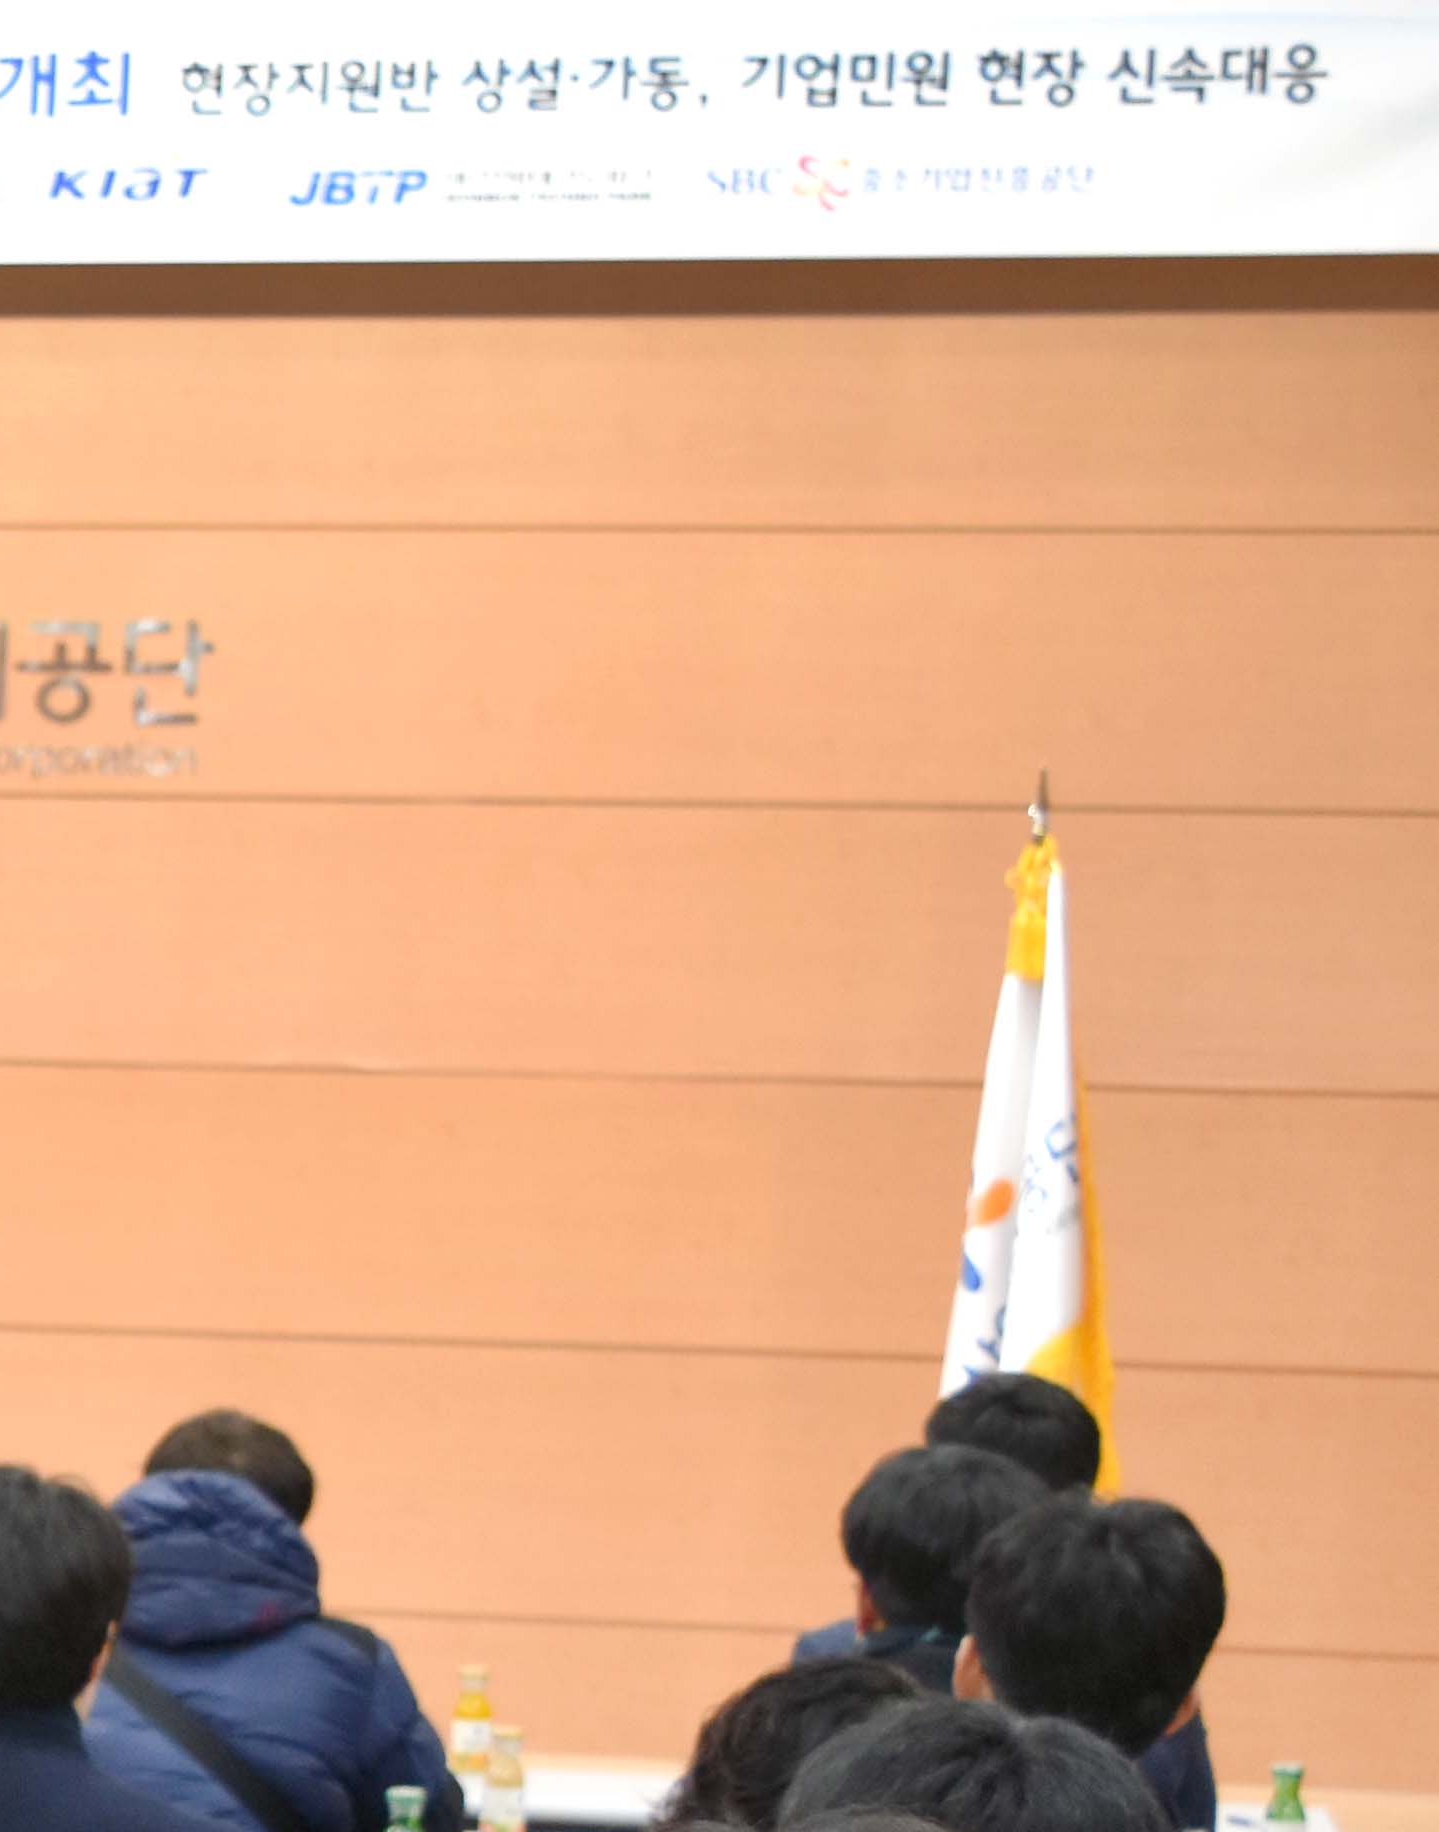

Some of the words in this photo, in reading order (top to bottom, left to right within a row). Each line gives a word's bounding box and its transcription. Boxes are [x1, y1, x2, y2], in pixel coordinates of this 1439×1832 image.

[181, 59, 440, 116] 현장지원반
[742, 50, 952, 109] 기업민원
[977, 47, 1087, 108] 현장
[1107, 42, 1329, 104] 신속대응
[289, 169, 429, 206] JBTP
